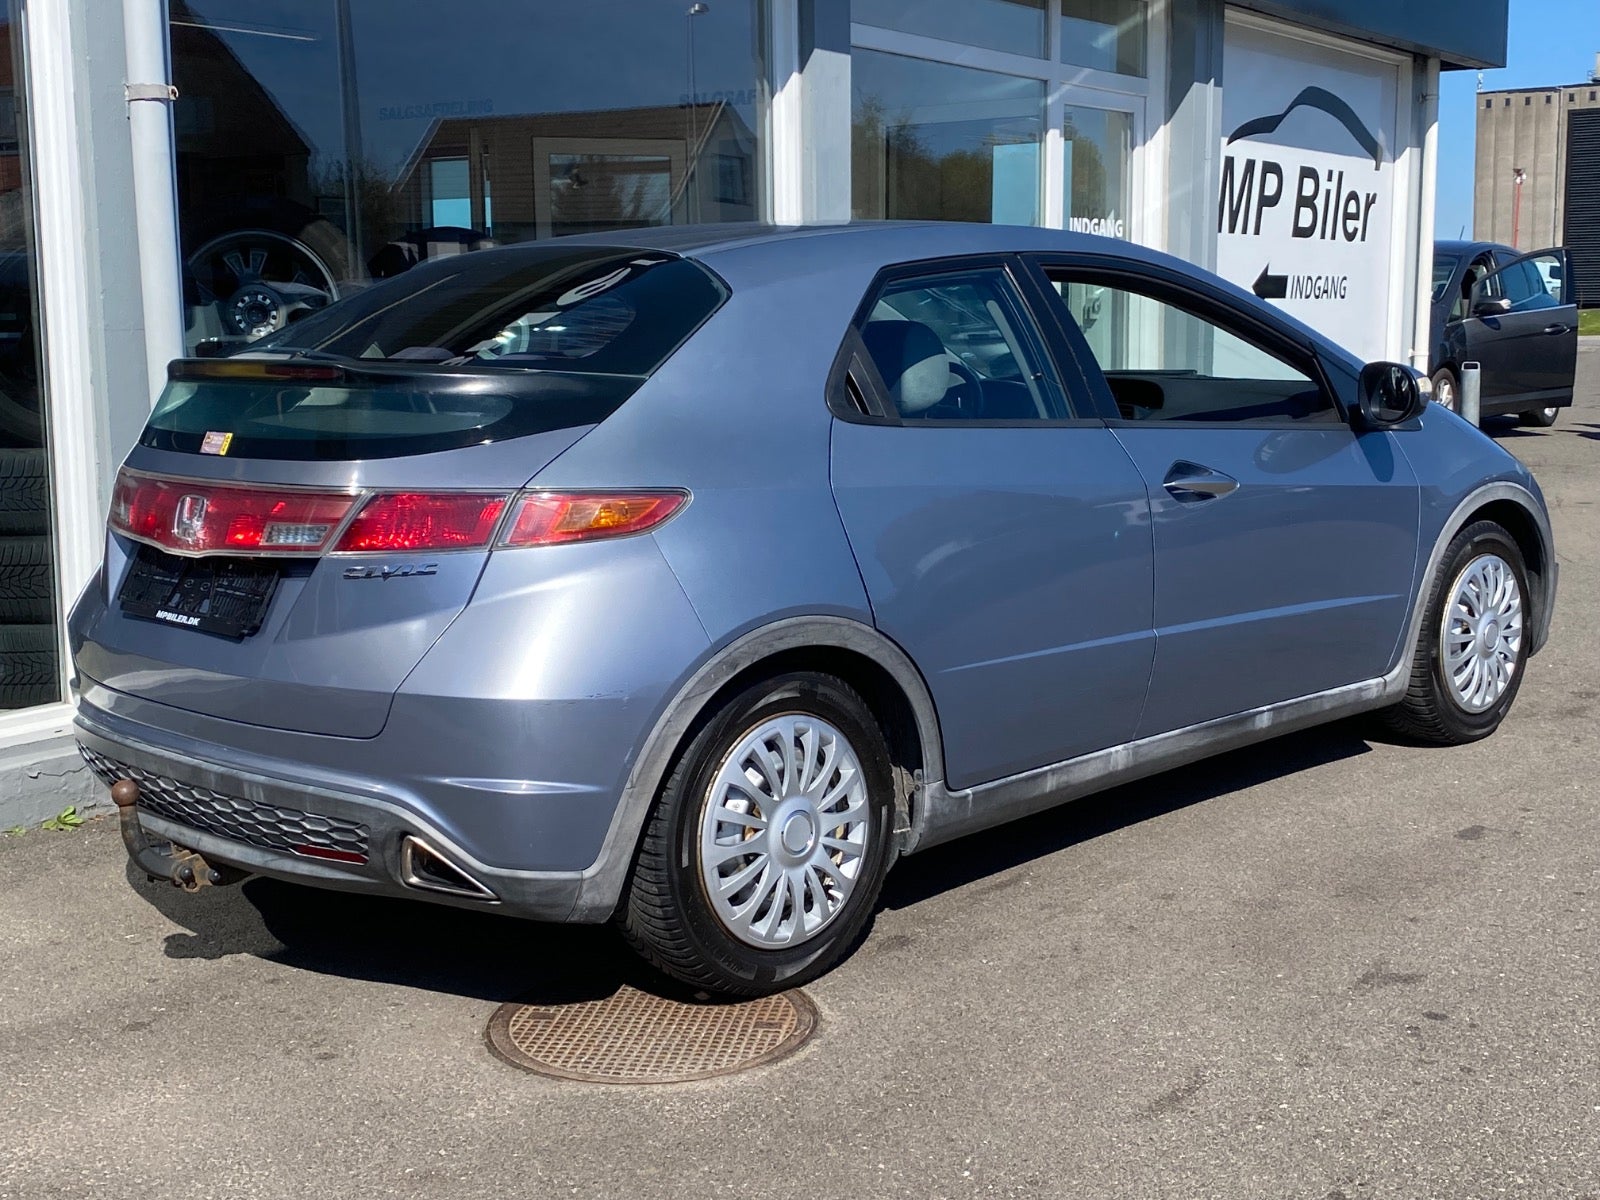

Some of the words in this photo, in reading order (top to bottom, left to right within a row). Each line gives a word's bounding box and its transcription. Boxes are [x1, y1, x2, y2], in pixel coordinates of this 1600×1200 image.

[1218, 156, 1283, 235] MP
[1292, 166, 1378, 242] Biler
[1069, 216, 1123, 238] INDGANG
[1291, 275, 1347, 300] INDGANG
[343, 564, 438, 581] CIVIC
[155, 610, 200, 627] MPBILER.DK
